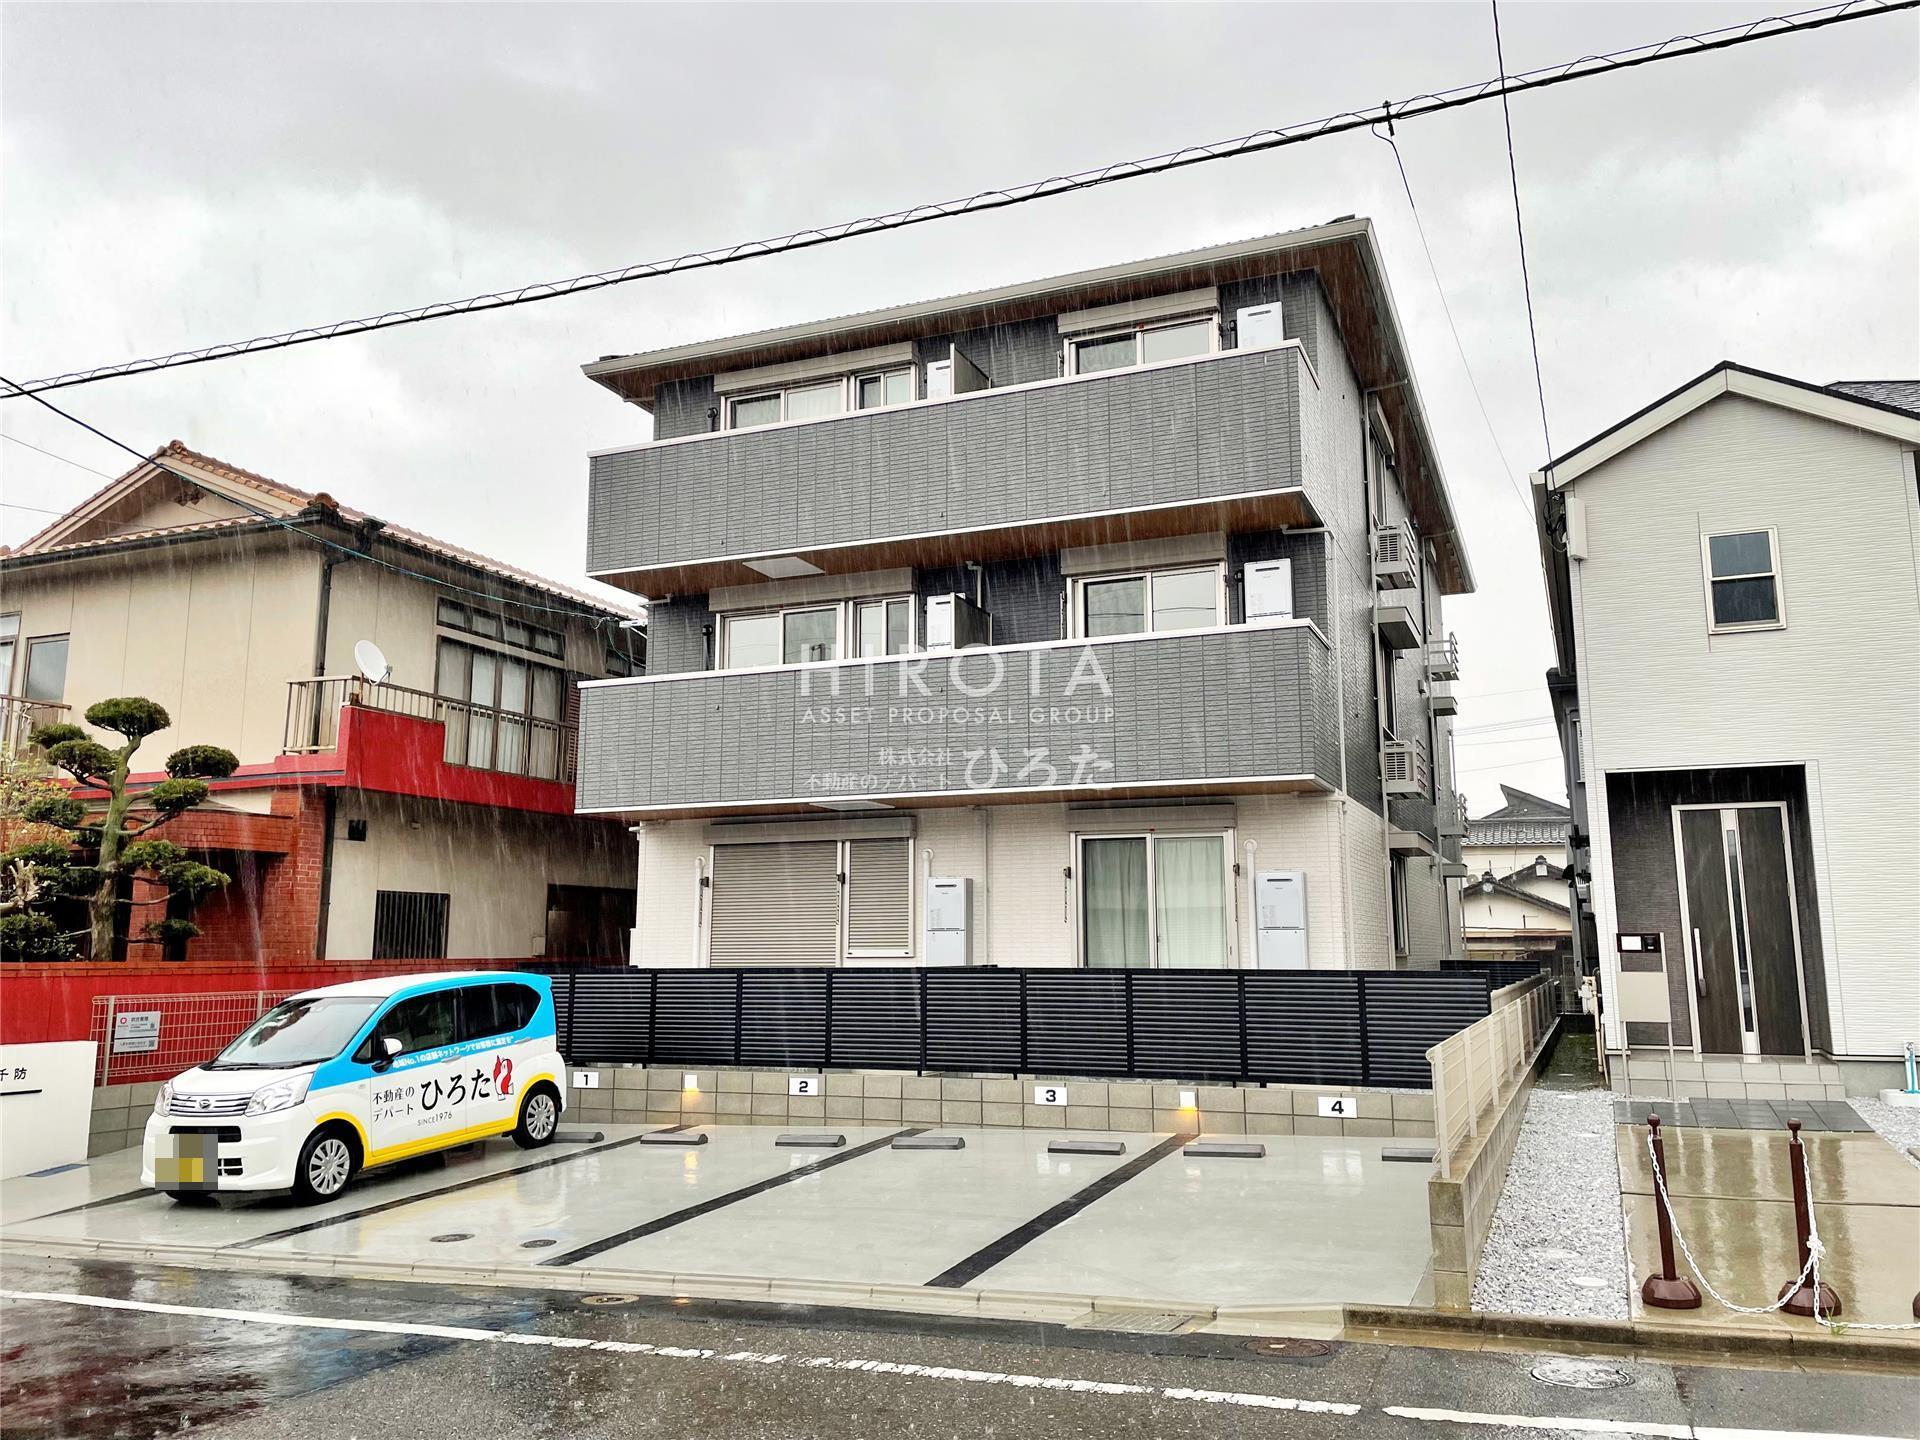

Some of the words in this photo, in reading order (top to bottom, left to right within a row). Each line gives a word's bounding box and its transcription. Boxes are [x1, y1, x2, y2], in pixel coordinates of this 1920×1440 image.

[583, 1074, 589, 1086] 1
[798, 1081, 808, 1093] 2
[372, 1086, 415, 1105] 不動産の
[420, 1068, 491, 1111] ひろた
[1045, 1089, 1056, 1102] 3
[372, 1103, 414, 1122] デパート
[1331, 1100, 1344, 1114] 4
